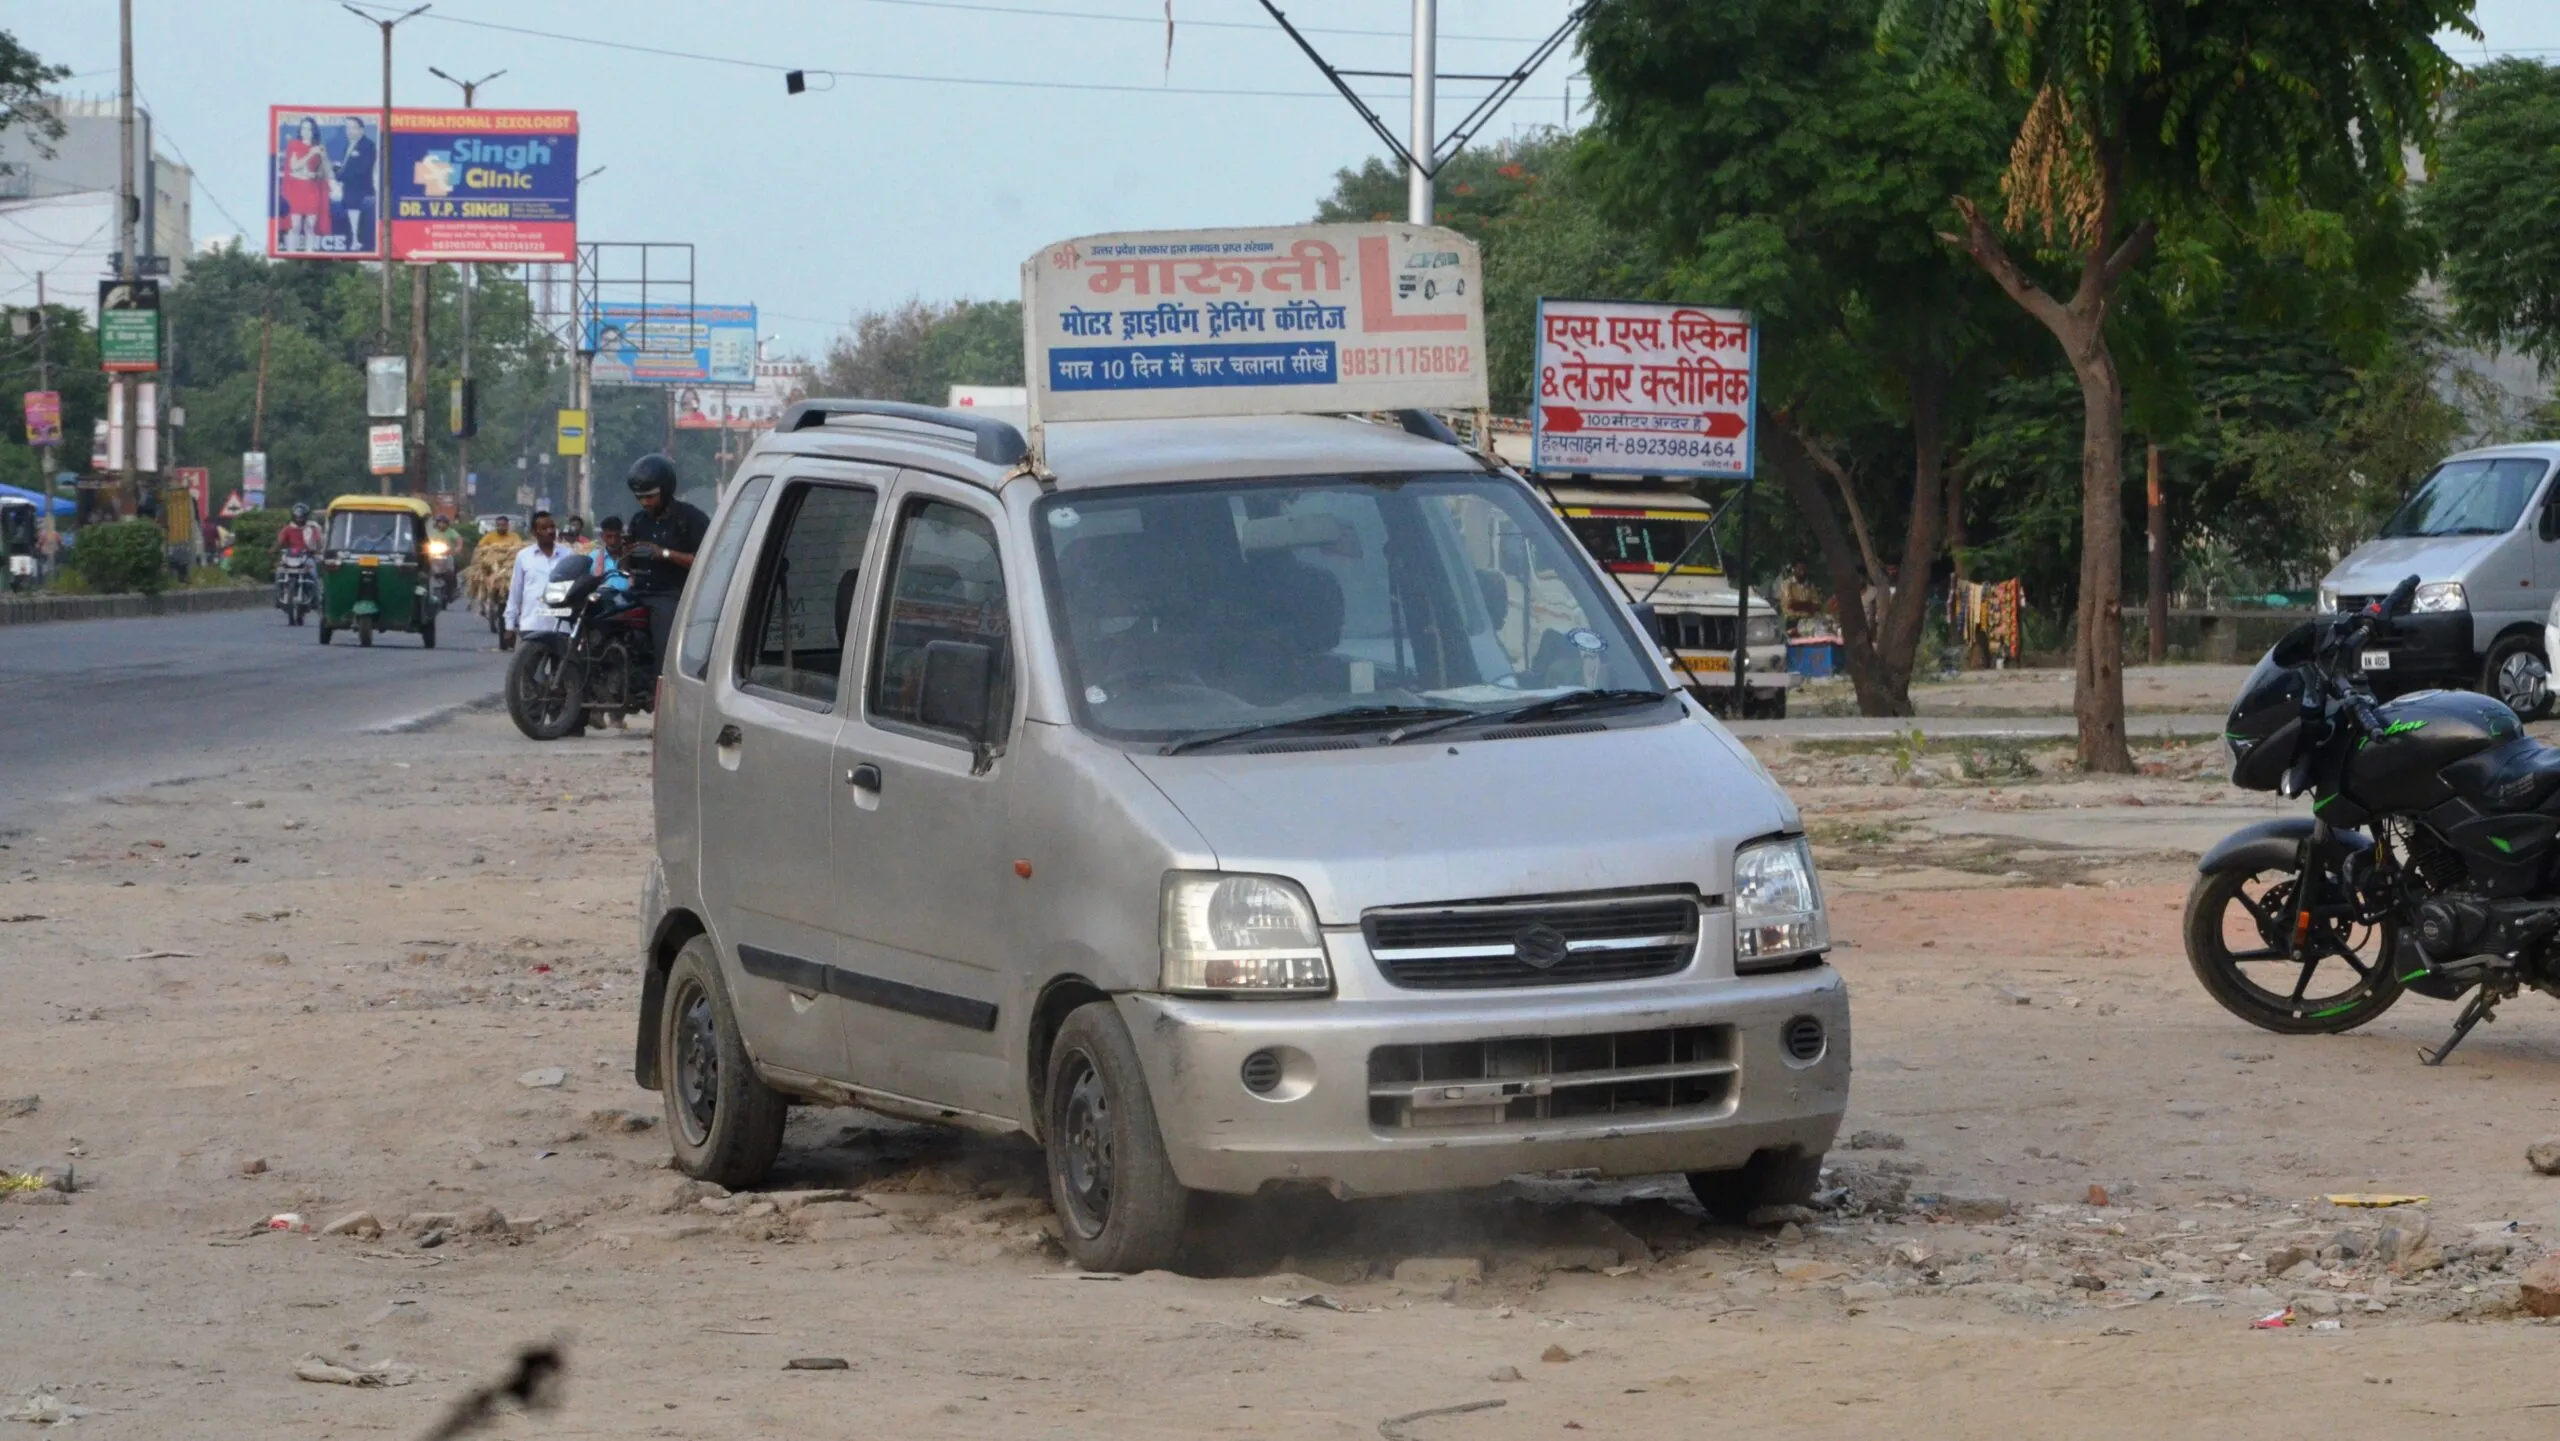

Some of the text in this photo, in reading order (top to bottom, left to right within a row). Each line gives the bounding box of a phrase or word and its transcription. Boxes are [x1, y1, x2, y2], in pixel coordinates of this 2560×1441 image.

[391, 114, 492, 129] INTERNATIONAL
[495, 116, 571, 129] SEXOLOGIST
[453, 138, 552, 170] Singh
[466, 168, 532, 189] Clinic
[399, 202, 426, 217] DR.
[430, 202, 457, 217] V.P.
[462, 202, 510, 218] SINGH
[1053, 243, 1078, 271] श्री
[1358, 236, 1468, 333] L
[1059, 300, 1346, 341] मोटर ड्राइविंग ट्रेनिंग कॉलेज
[1544, 310, 1749, 354] एस. एस. स्किन
[1059, 348, 1329, 380] मात्र 10 दिन में कार चलाना सीखें
[1342, 346, 1470, 377] 9837175862
[1541, 351, 1749, 406] & लेजर क्लीनिक
[1541, 432, 1601, 454] हेल्पलाइन
